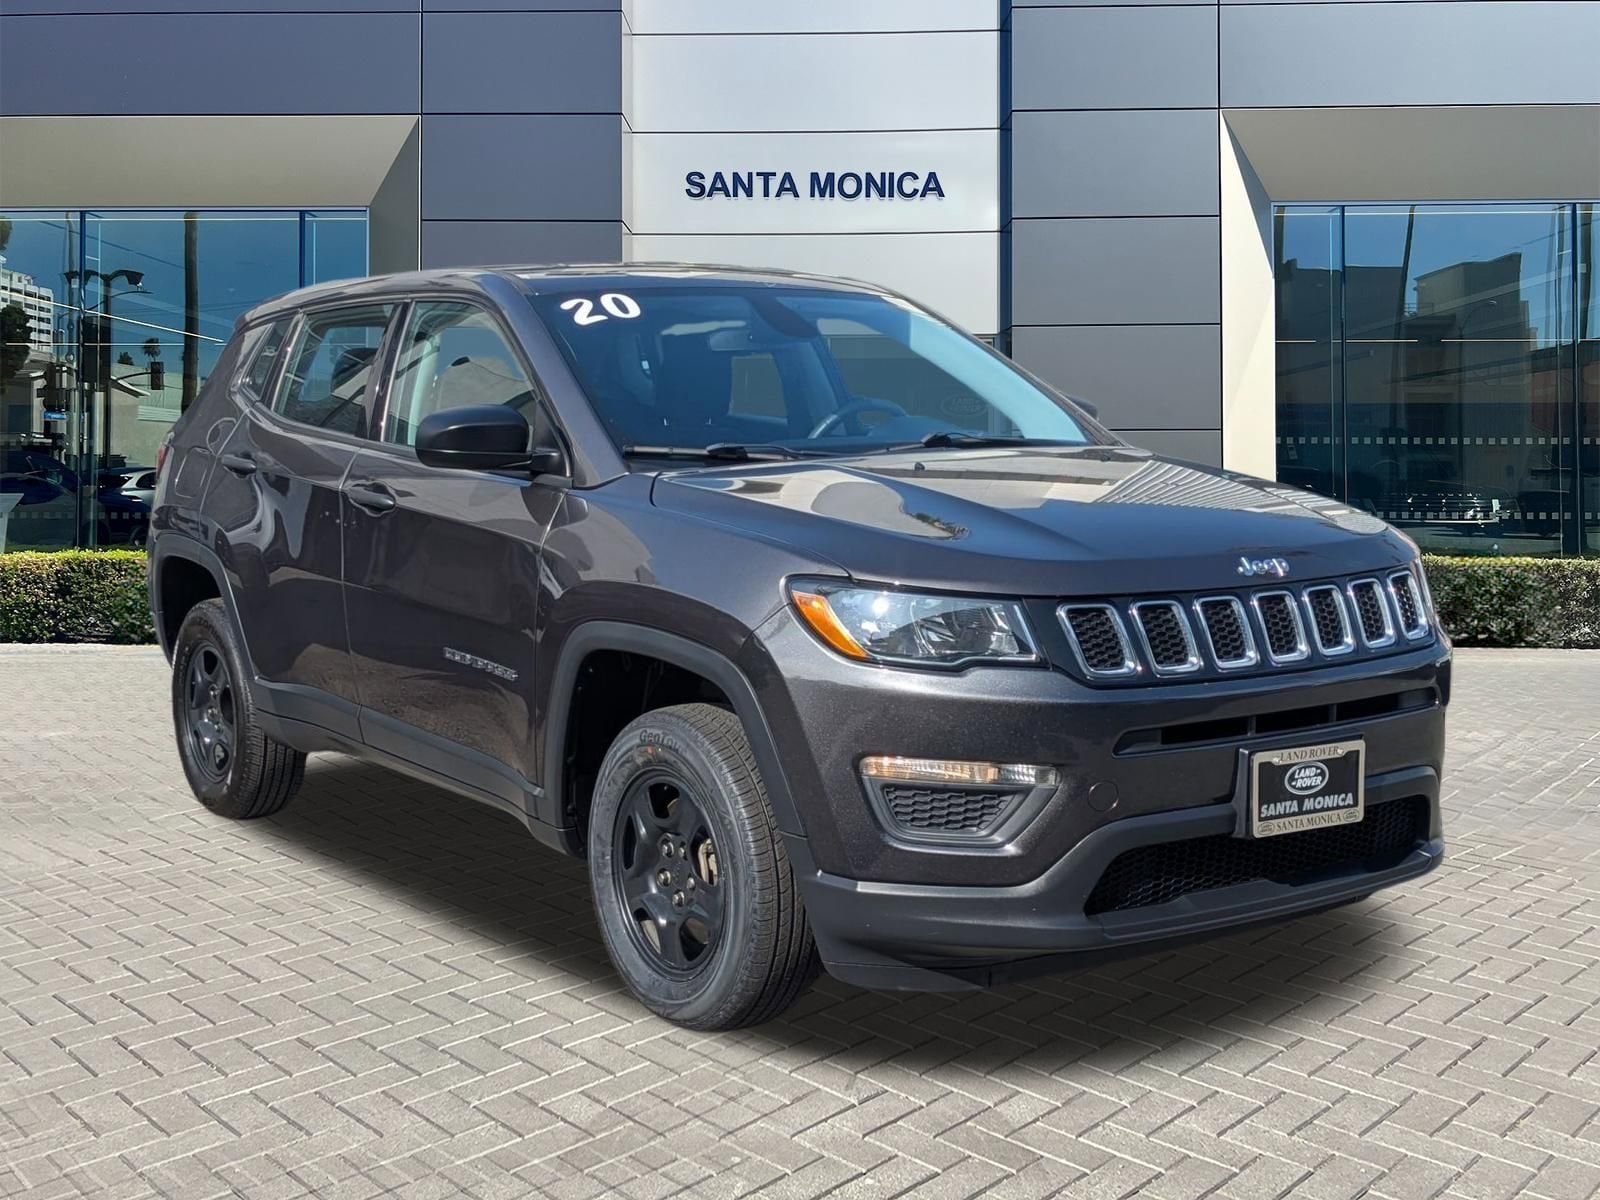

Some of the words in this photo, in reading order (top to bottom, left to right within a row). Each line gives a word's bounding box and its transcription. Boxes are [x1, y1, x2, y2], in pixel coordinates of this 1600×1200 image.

[685, 171, 800, 199] SANTA
[809, 171, 945, 199] MONICA
[560, 293, 641, 326] 20
[1237, 556, 1290, 577] Jeep
[1279, 750, 1308, 761] LAND
[1308, 746, 1339, 759] ROVER
[1294, 767, 1317, 778] LAND
[1295, 777, 1322, 788] ROVER
[1260, 801, 1299, 817] SANTA
[1302, 793, 1353, 811] MONICA
[1276, 818, 1305, 832] SANTA
[1306, 814, 1341, 828] MONICA
